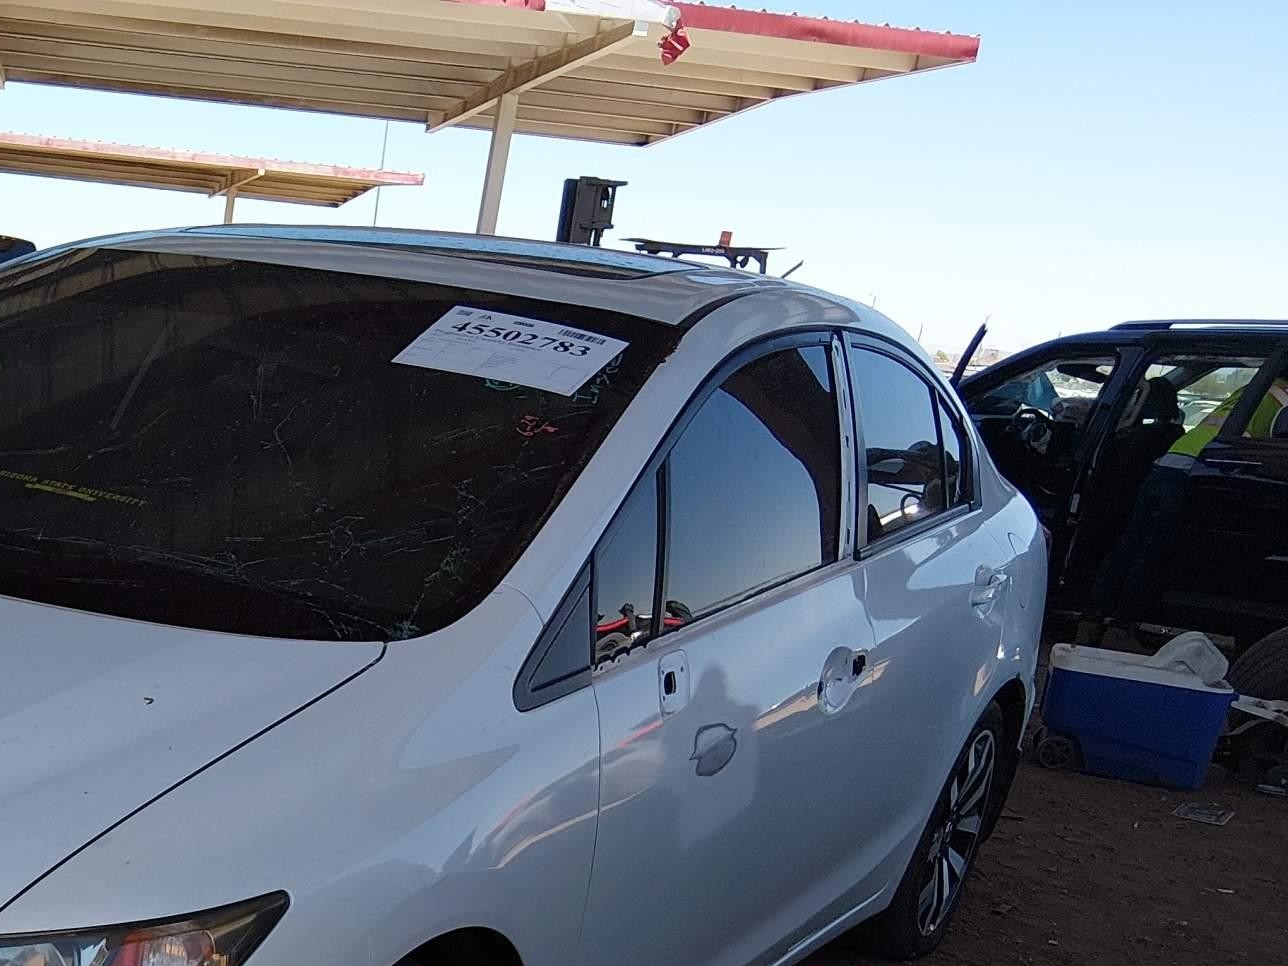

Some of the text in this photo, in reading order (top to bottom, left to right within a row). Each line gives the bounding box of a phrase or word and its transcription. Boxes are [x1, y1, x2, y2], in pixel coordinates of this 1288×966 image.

[451, 320, 592, 357] 45502783
[42, 479, 78, 491] STATE
[78, 486, 149, 507] UNIVERSITY
